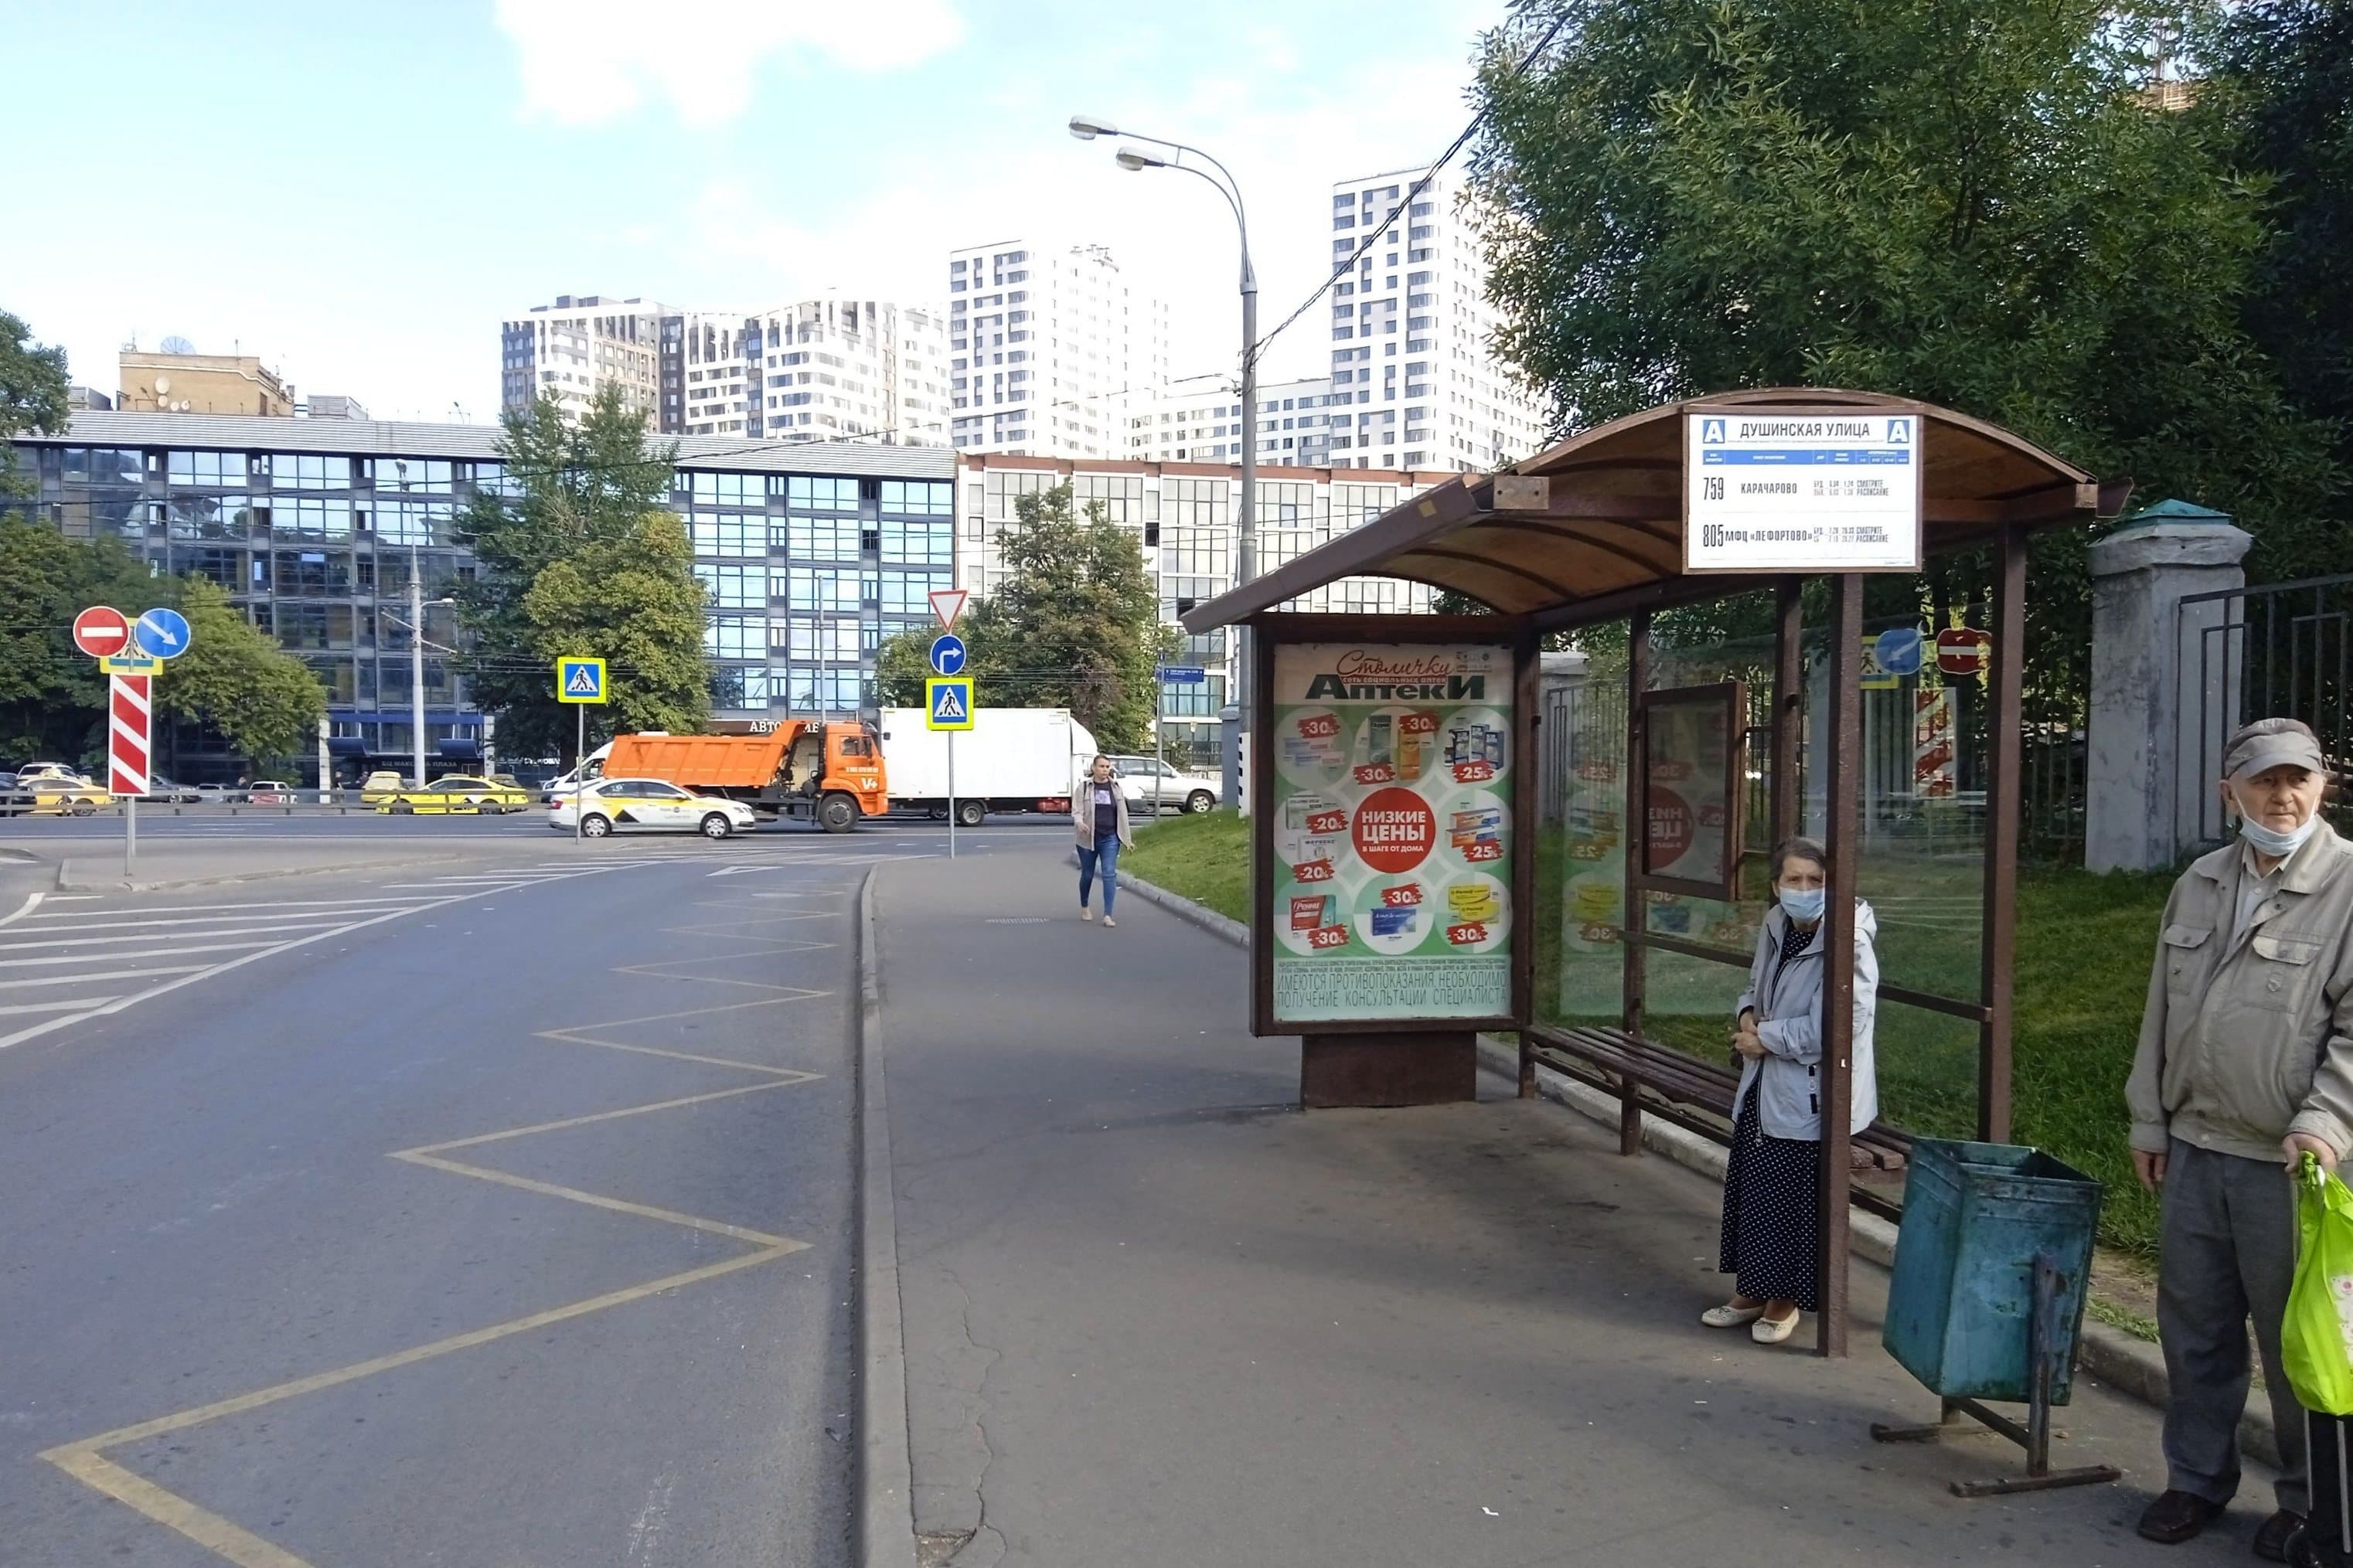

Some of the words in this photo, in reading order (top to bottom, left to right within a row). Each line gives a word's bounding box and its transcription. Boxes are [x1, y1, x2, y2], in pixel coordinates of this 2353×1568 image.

[1740, 423, 1822, 439] ДУШИНСКАЯ
[1827, 423, 1871, 438] УЛИЦА
[1703, 477, 1725, 500] 759
[1741, 482, 1798, 495] КАРАЧАРОВО
[1703, 524, 1725, 547] 805
[1725, 529, 1748, 543] МФЦ
[1337, 650, 1454, 675] Столички
[1362, 811, 1426, 824] НИЗКИЕ
[1362, 824, 1425, 844] ЦЕНЫ
[1278, 974, 1326, 991] ИМЕЮТСЯ
[1439, 971, 1507, 988] НЕОБХОДИМО
[1278, 990, 1338, 1008] ПОЛУЧЕНИЕ
[1346, 988, 1426, 1007] КОНСУЛЬТАЦИИ
[1434, 987, 1507, 1005] СПЕЦИАЛИСТА
